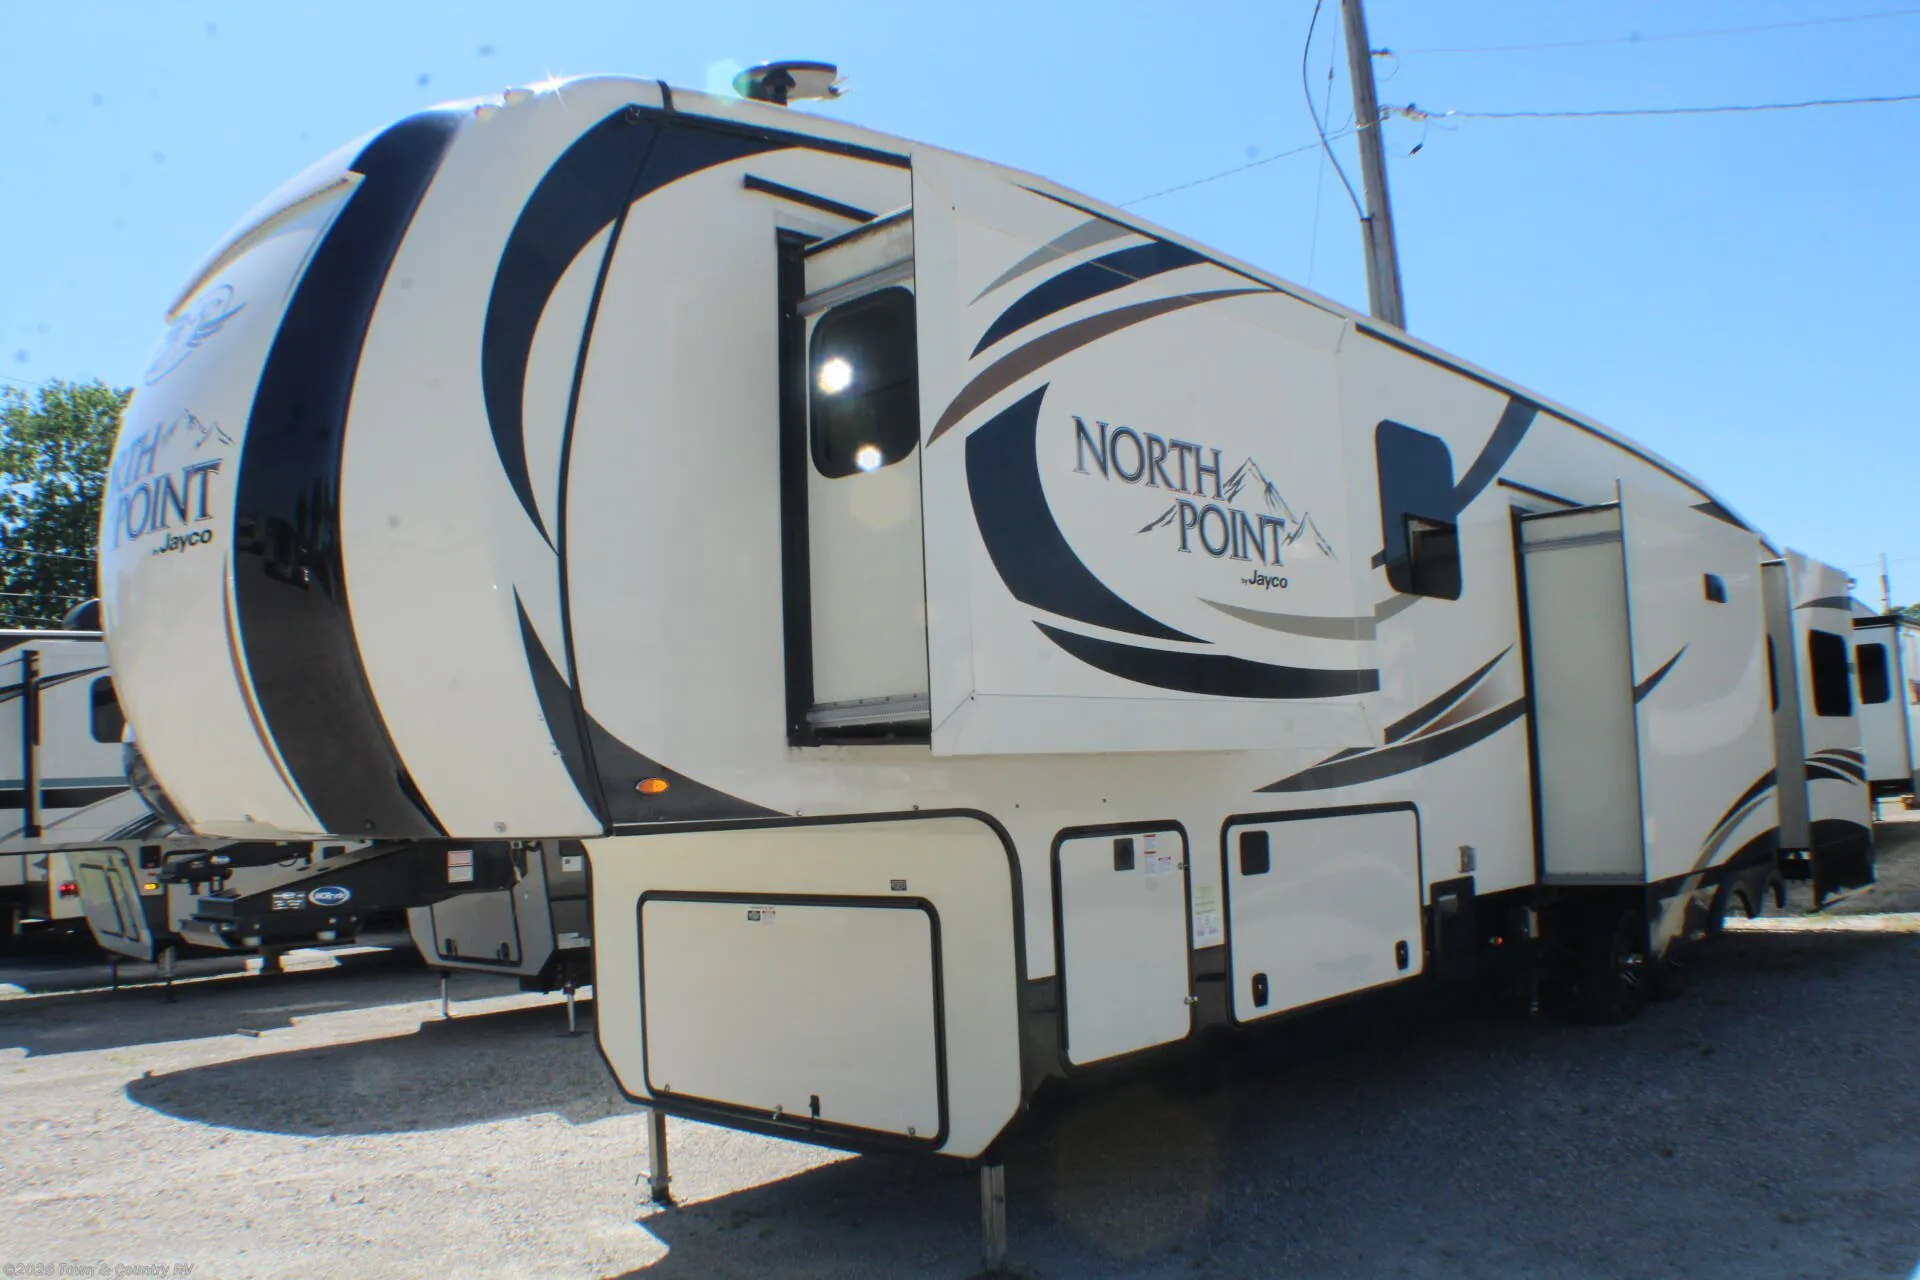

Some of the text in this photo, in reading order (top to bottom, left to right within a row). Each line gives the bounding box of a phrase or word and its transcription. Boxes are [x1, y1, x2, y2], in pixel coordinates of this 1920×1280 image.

[1072, 415, 1226, 501] NORTH
[112, 458, 222, 549] POINT
[1176, 498, 1286, 567] POINT
[159, 529, 213, 553] Jayco
[1248, 569, 1288, 590] Jayco
